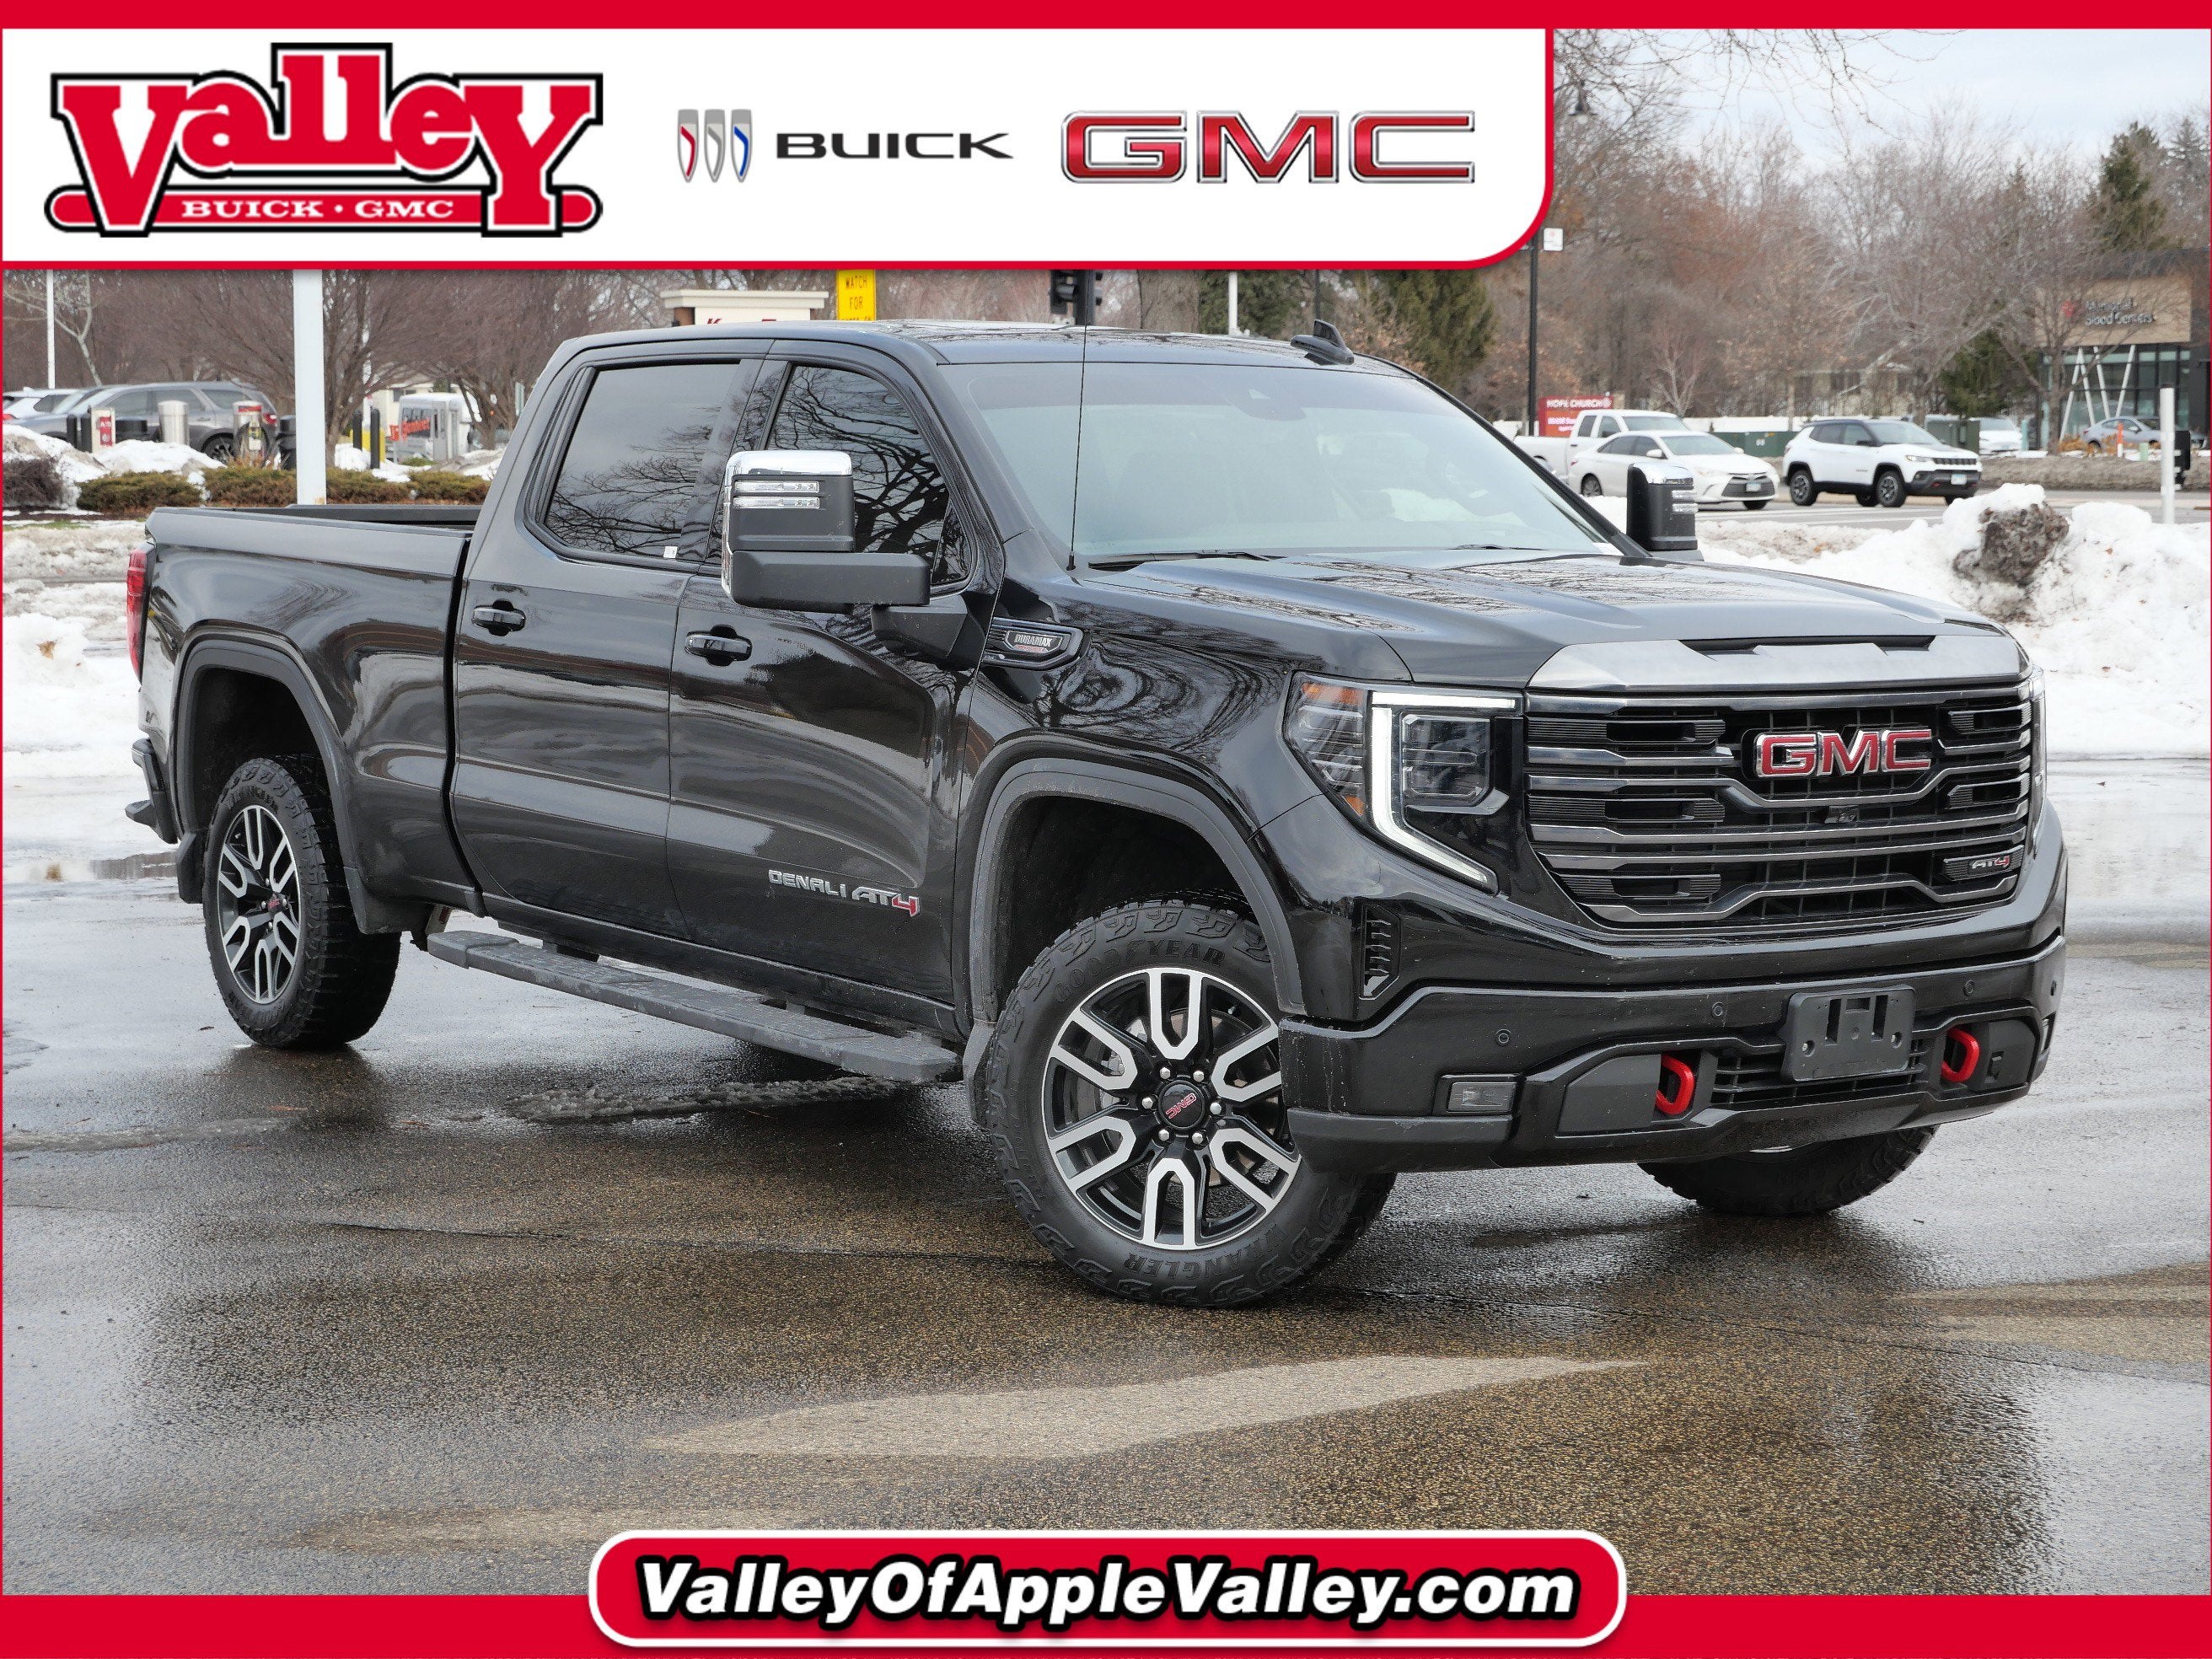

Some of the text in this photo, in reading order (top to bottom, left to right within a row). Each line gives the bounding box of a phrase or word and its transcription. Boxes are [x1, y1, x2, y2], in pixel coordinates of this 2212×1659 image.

[845, 275, 867, 289] WATCH
[849, 297, 863, 310] FOR
[1014, 633, 1053, 647] DURAMAX
[1756, 728, 1932, 778] GMC
[1971, 855, 2011, 870] AT4
[768, 869, 921, 917] DENALI AT4
[1165, 1093, 1197, 1119] GMC
